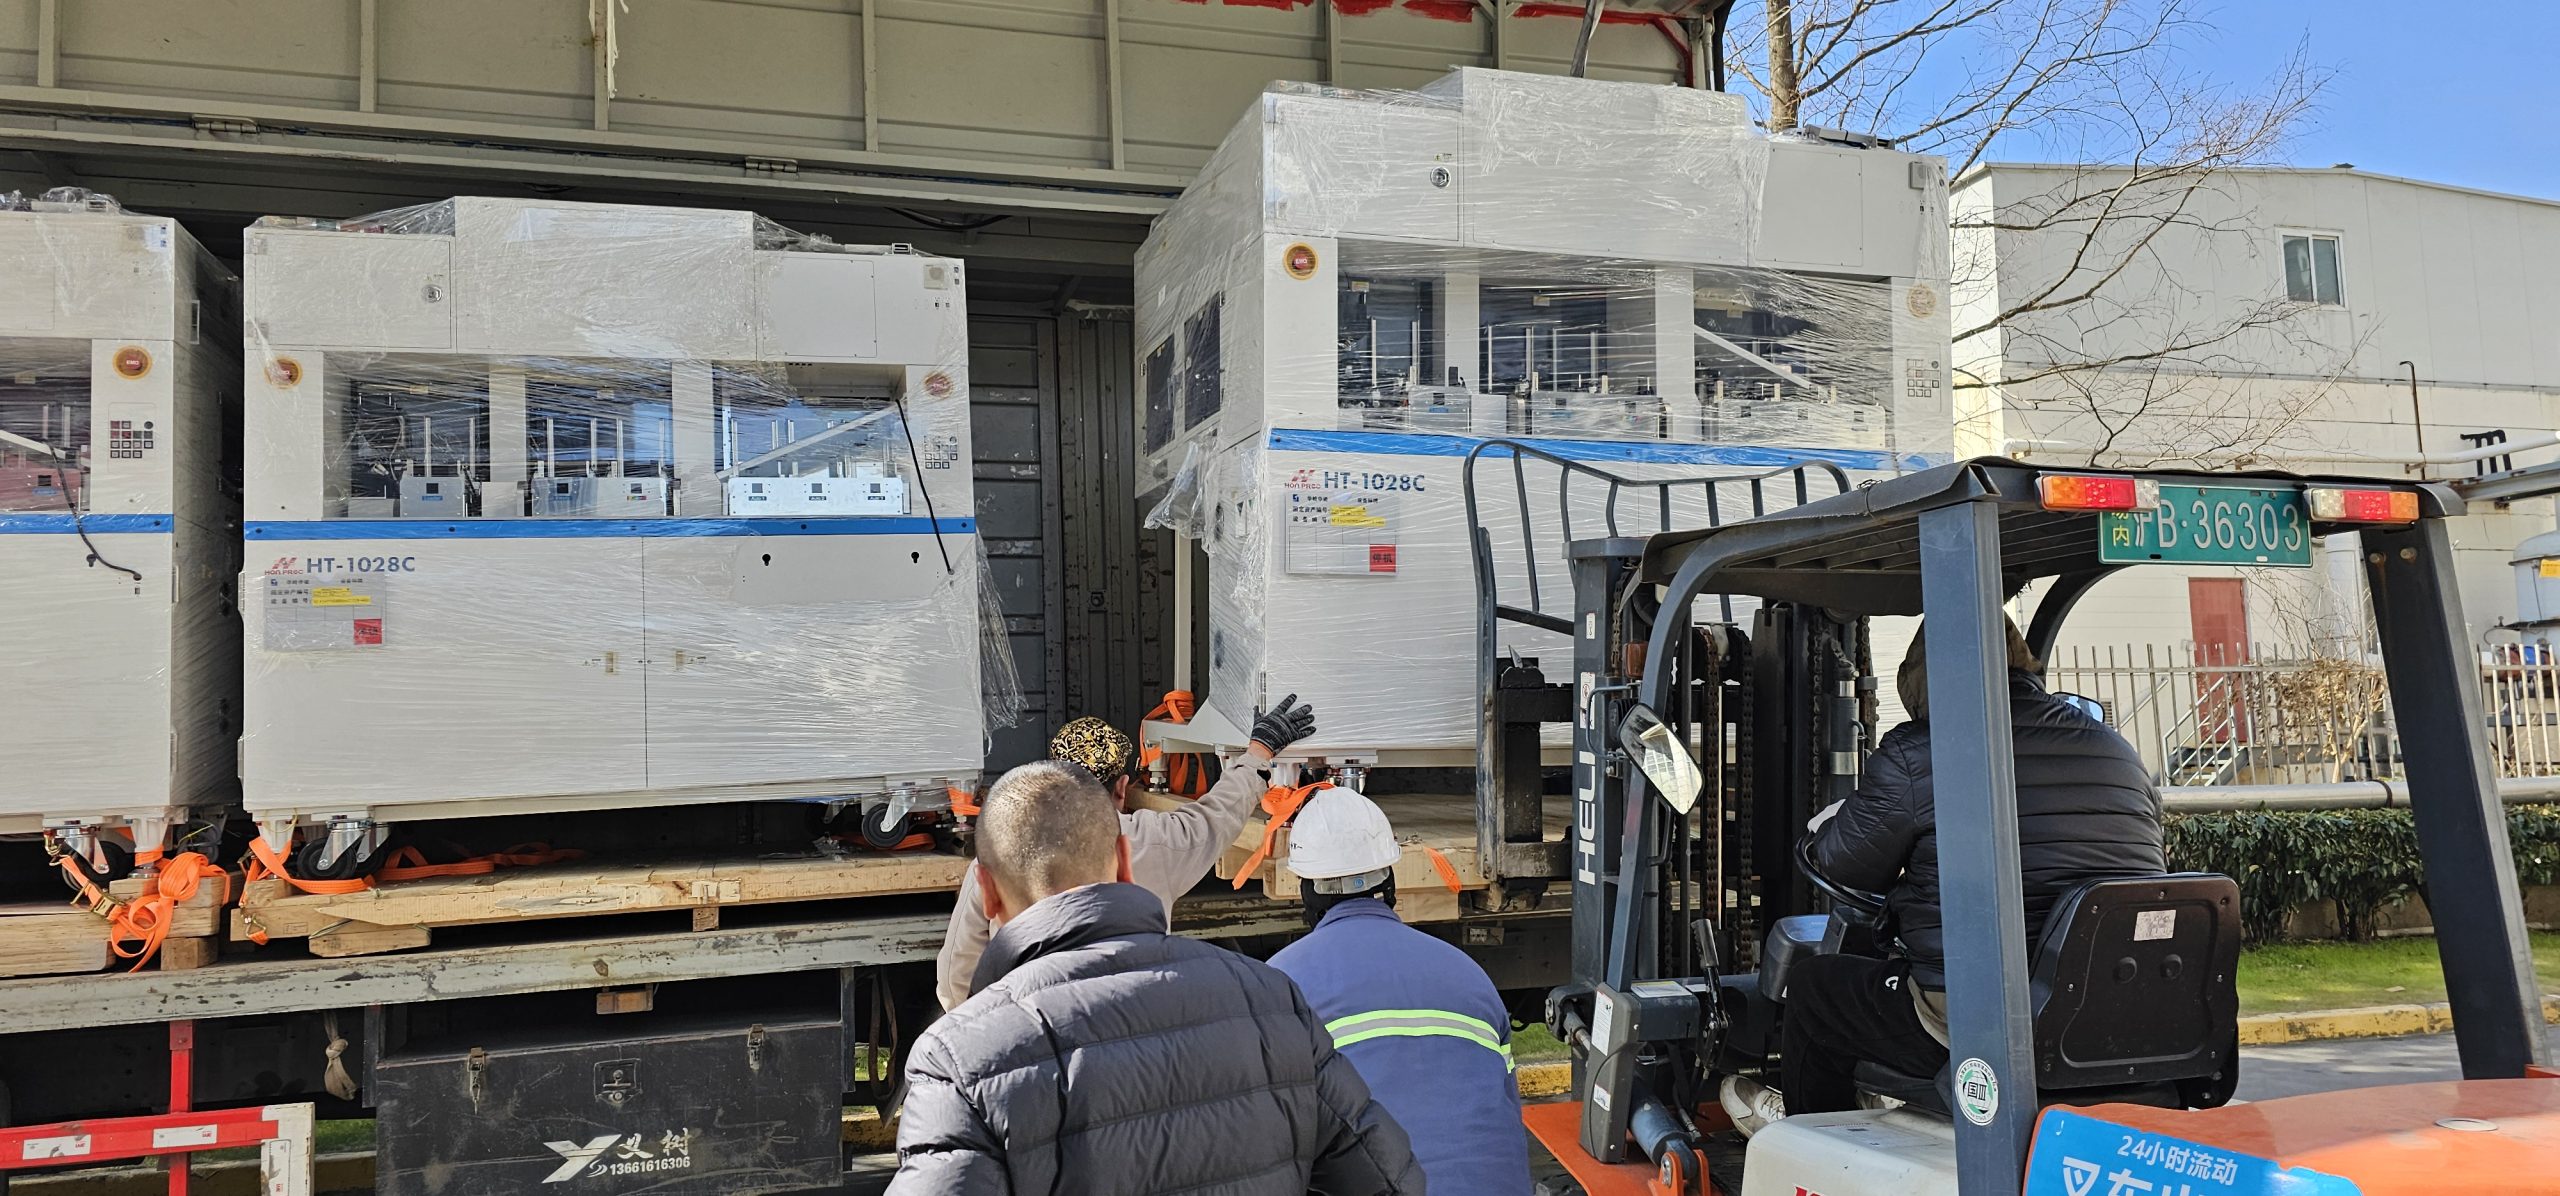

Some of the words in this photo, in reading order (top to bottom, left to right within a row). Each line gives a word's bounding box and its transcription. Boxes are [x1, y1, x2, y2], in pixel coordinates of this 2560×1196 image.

[1324, 471, 1425, 492] HT-1028C
[307, 556, 415, 574] HT-1028C
[1578, 751, 1596, 885] HELI
[609, 1156, 691, 1176] 13661616306
[2117, 1135, 2238, 1186] 24小时流动
